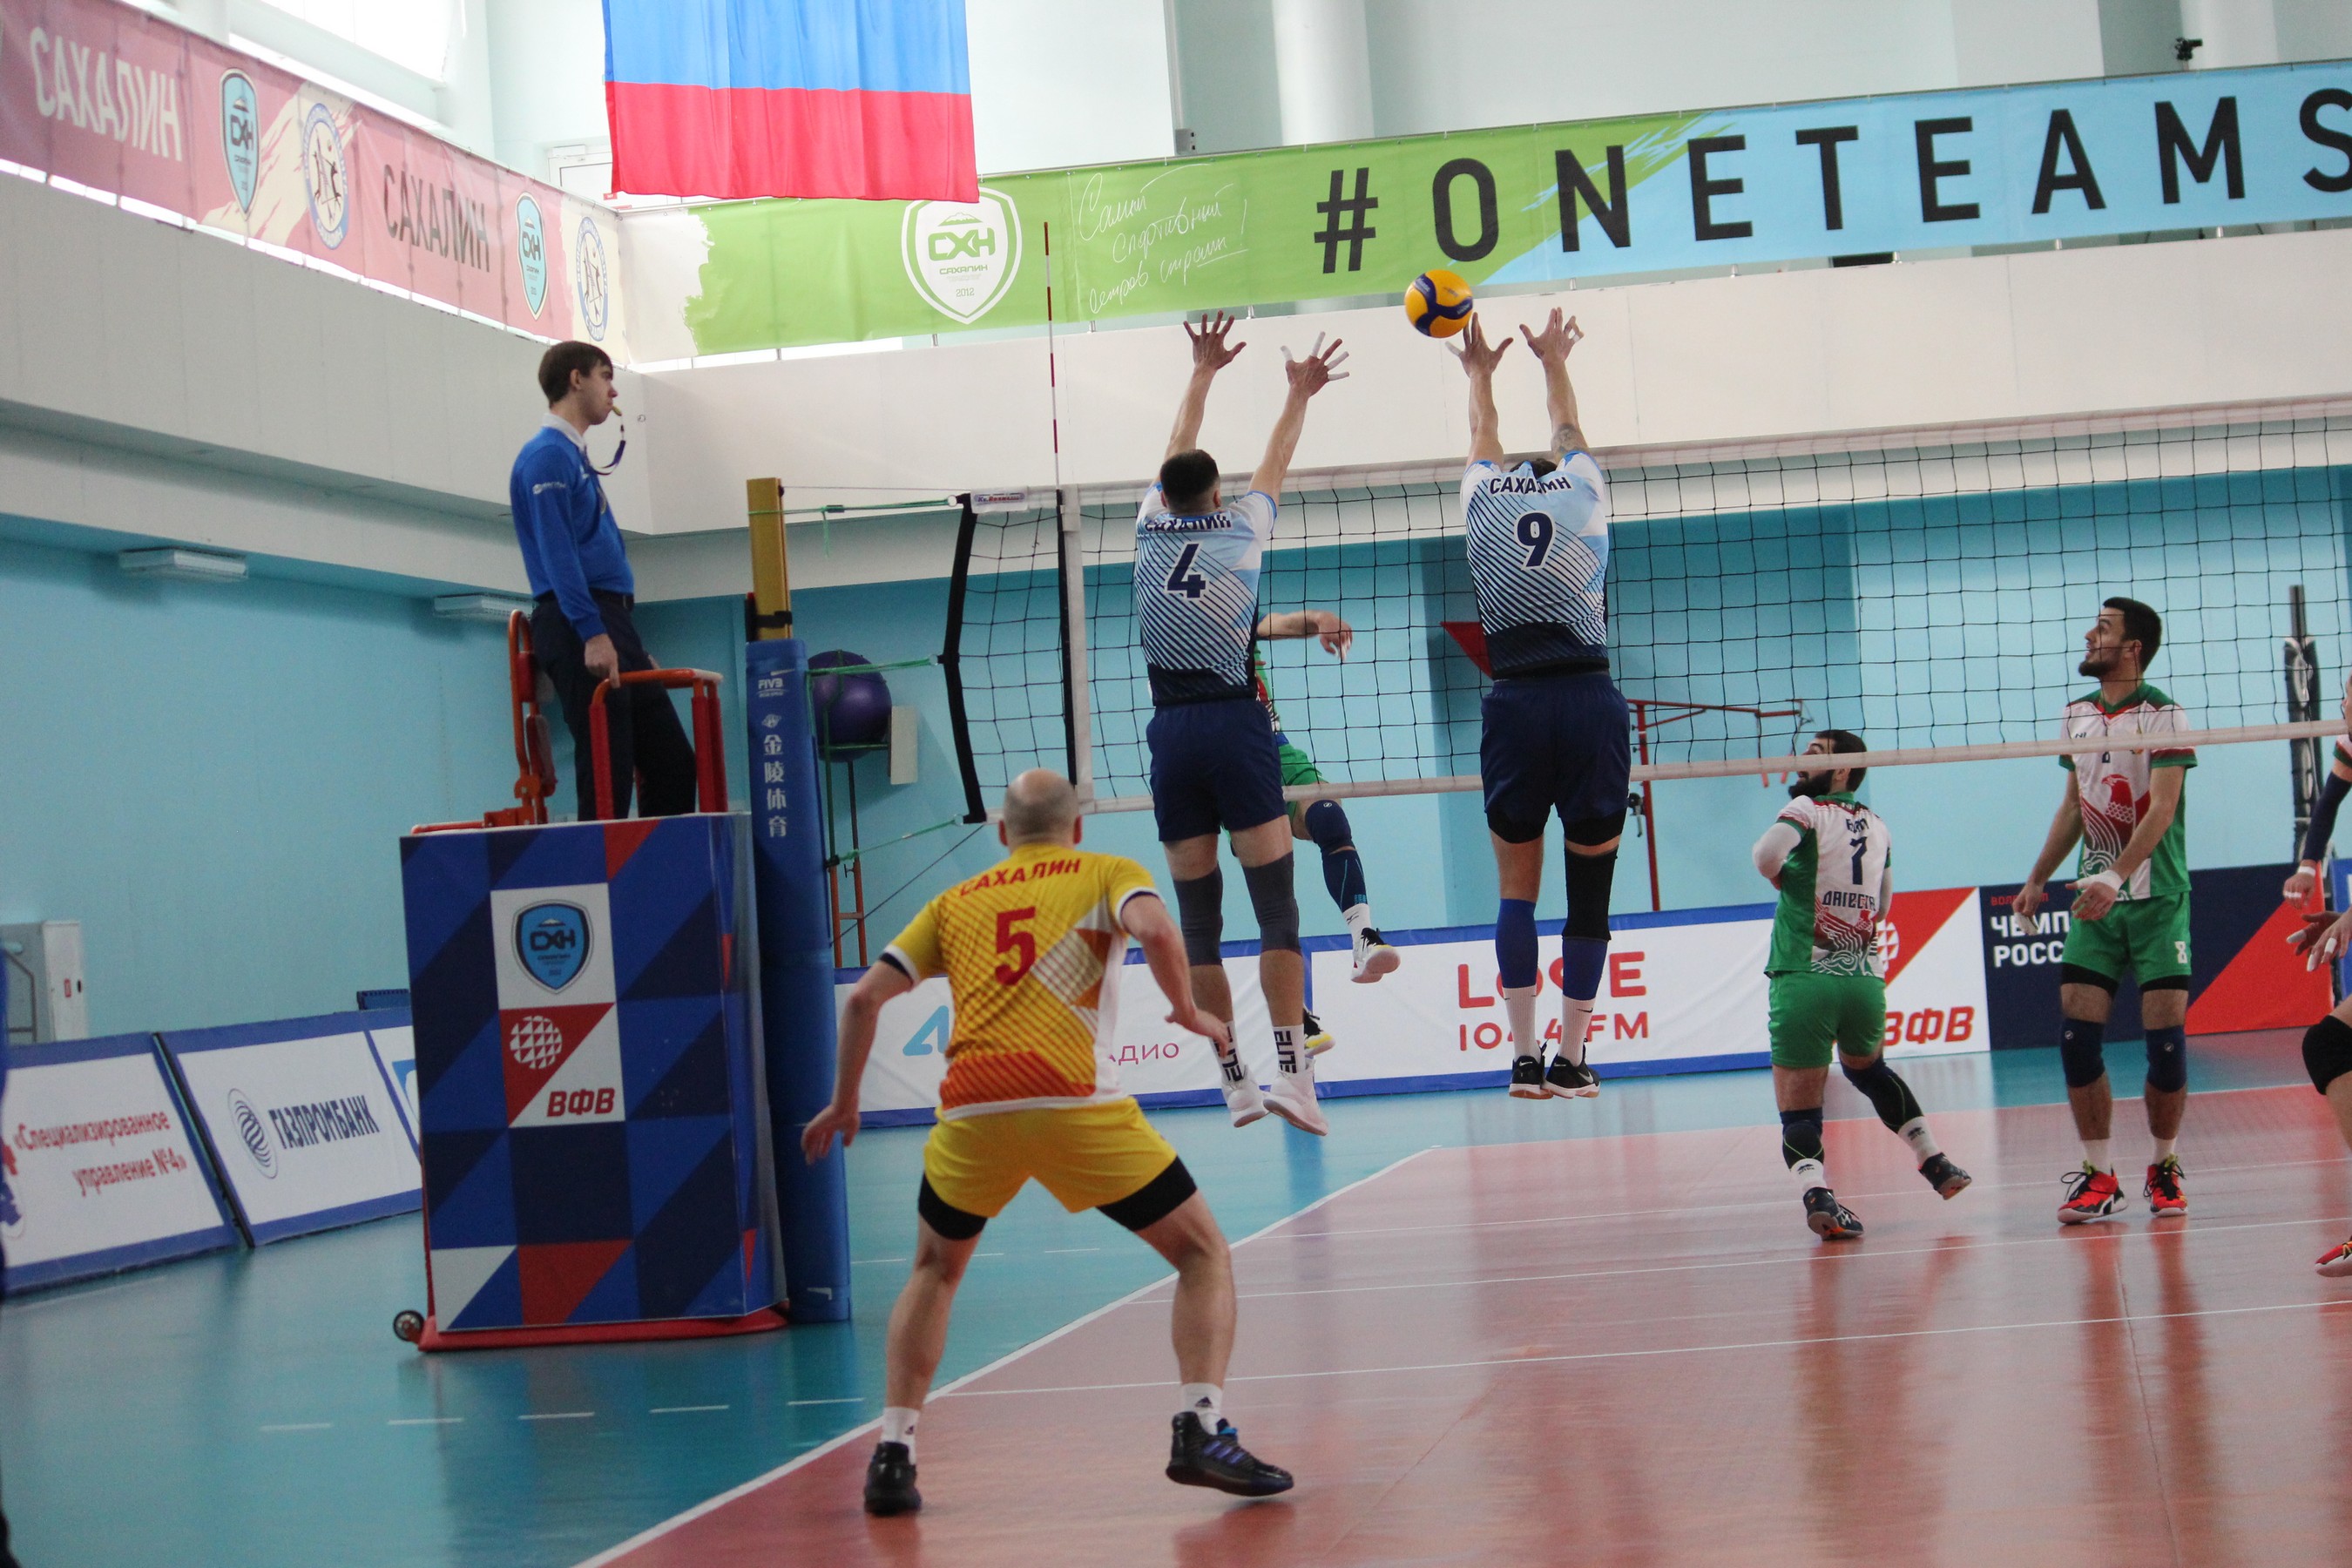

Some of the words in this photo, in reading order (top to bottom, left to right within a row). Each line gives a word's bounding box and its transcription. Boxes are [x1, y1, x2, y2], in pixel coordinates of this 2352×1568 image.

[30, 26, 182, 162] САХАЛИН
[383, 164, 490, 273] САХАЛИН
[956, 287, 975, 297] 2012
[1517, 512, 1553, 567] 9
[1167, 544, 1206, 598] 4
[960, 858, 1081, 897] САХАЛИН
[1822, 890, 1876, 911] ДАГЕСТА
[1990, 911, 2071, 938] ЧЕМП
[995, 906, 1036, 986] 5
[1993, 940, 2065, 968] РОСС
[1108, 1043, 1179, 1065] ДИО
[546, 1086, 615, 1117] ВФВ
[267, 1095, 380, 1149] ГАЗПРОМБАНК
